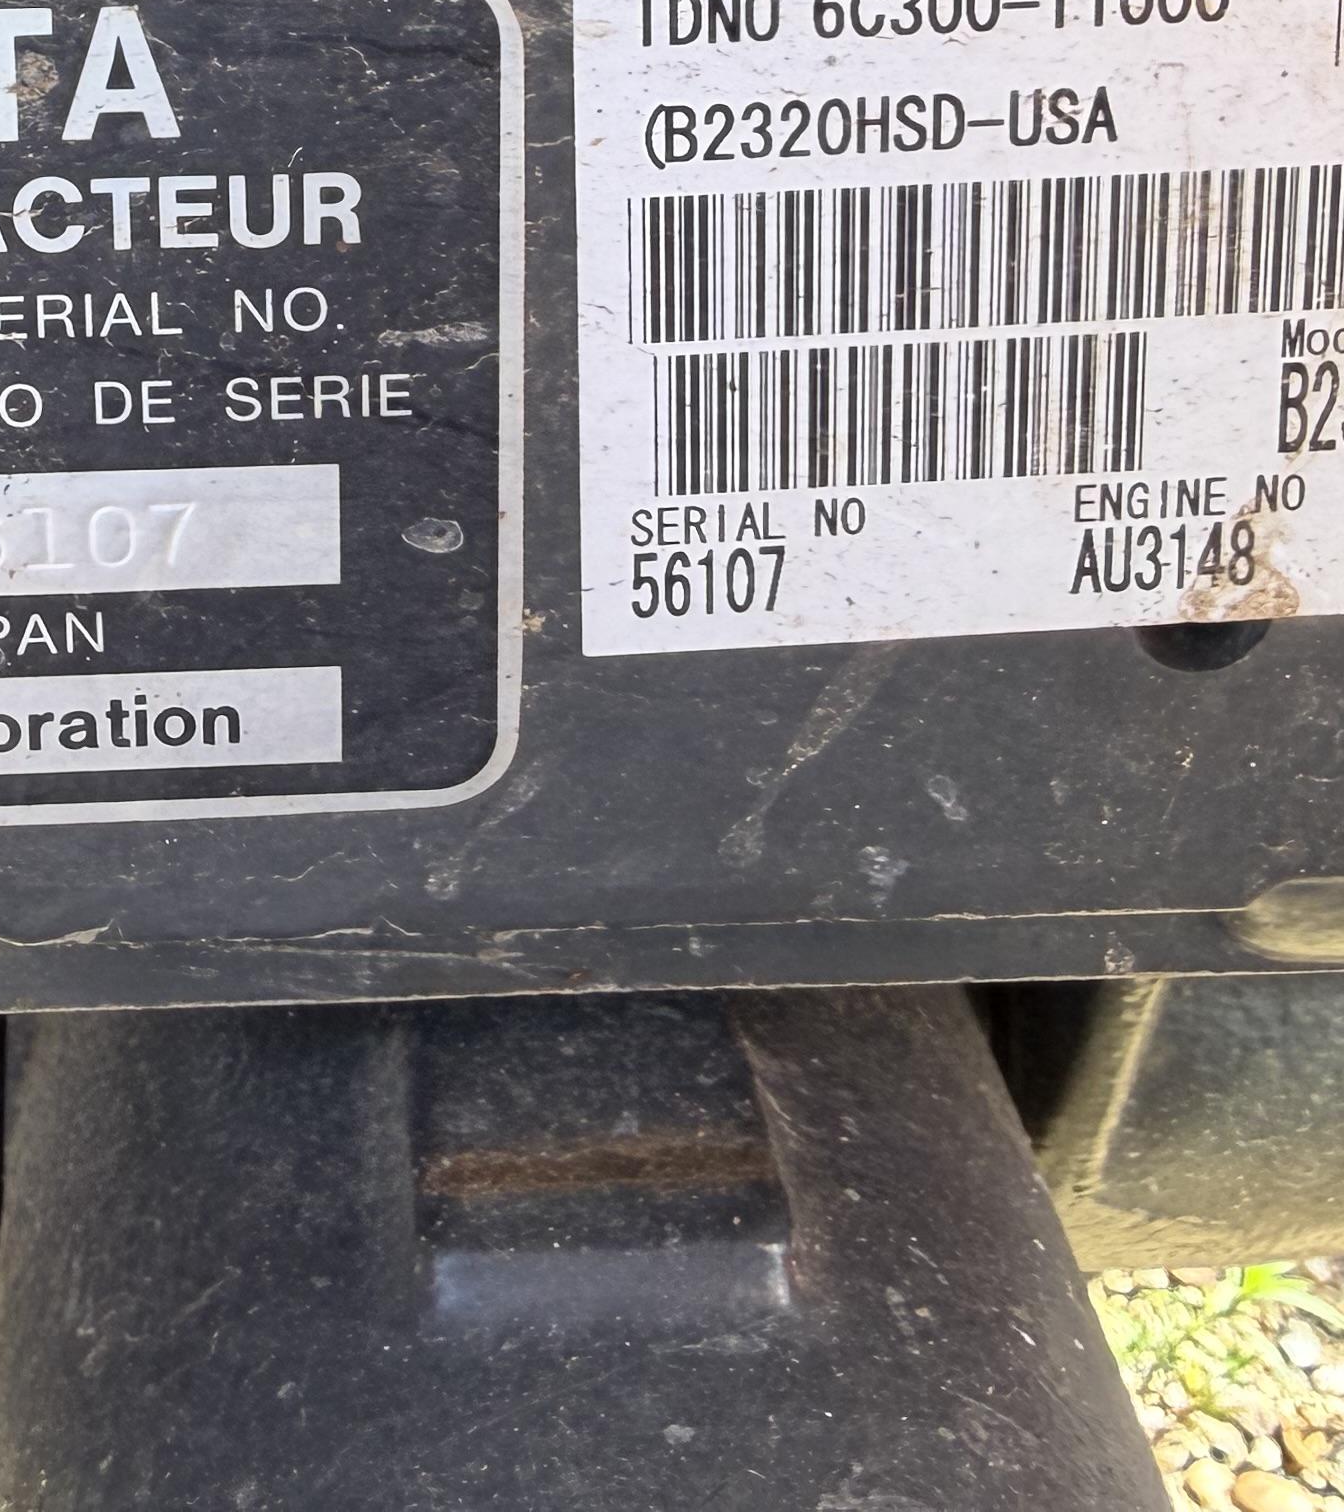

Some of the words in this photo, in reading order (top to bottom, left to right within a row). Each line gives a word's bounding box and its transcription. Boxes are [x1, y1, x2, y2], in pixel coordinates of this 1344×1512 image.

[643, 86, 1118, 170] (B2320HSD-USA
[233, 285, 346, 334] NO.
[94, 380, 175, 426] DE
[224, 372, 413, 422] SERIE
[630, 501, 787, 546] SERIAL
[813, 497, 866, 537] NO
[1074, 477, 1228, 523] ENGINE
[1254, 474, 1305, 516] NO
[631, 546, 785, 618] 56107
[1069, 520, 1258, 595] AU3148
